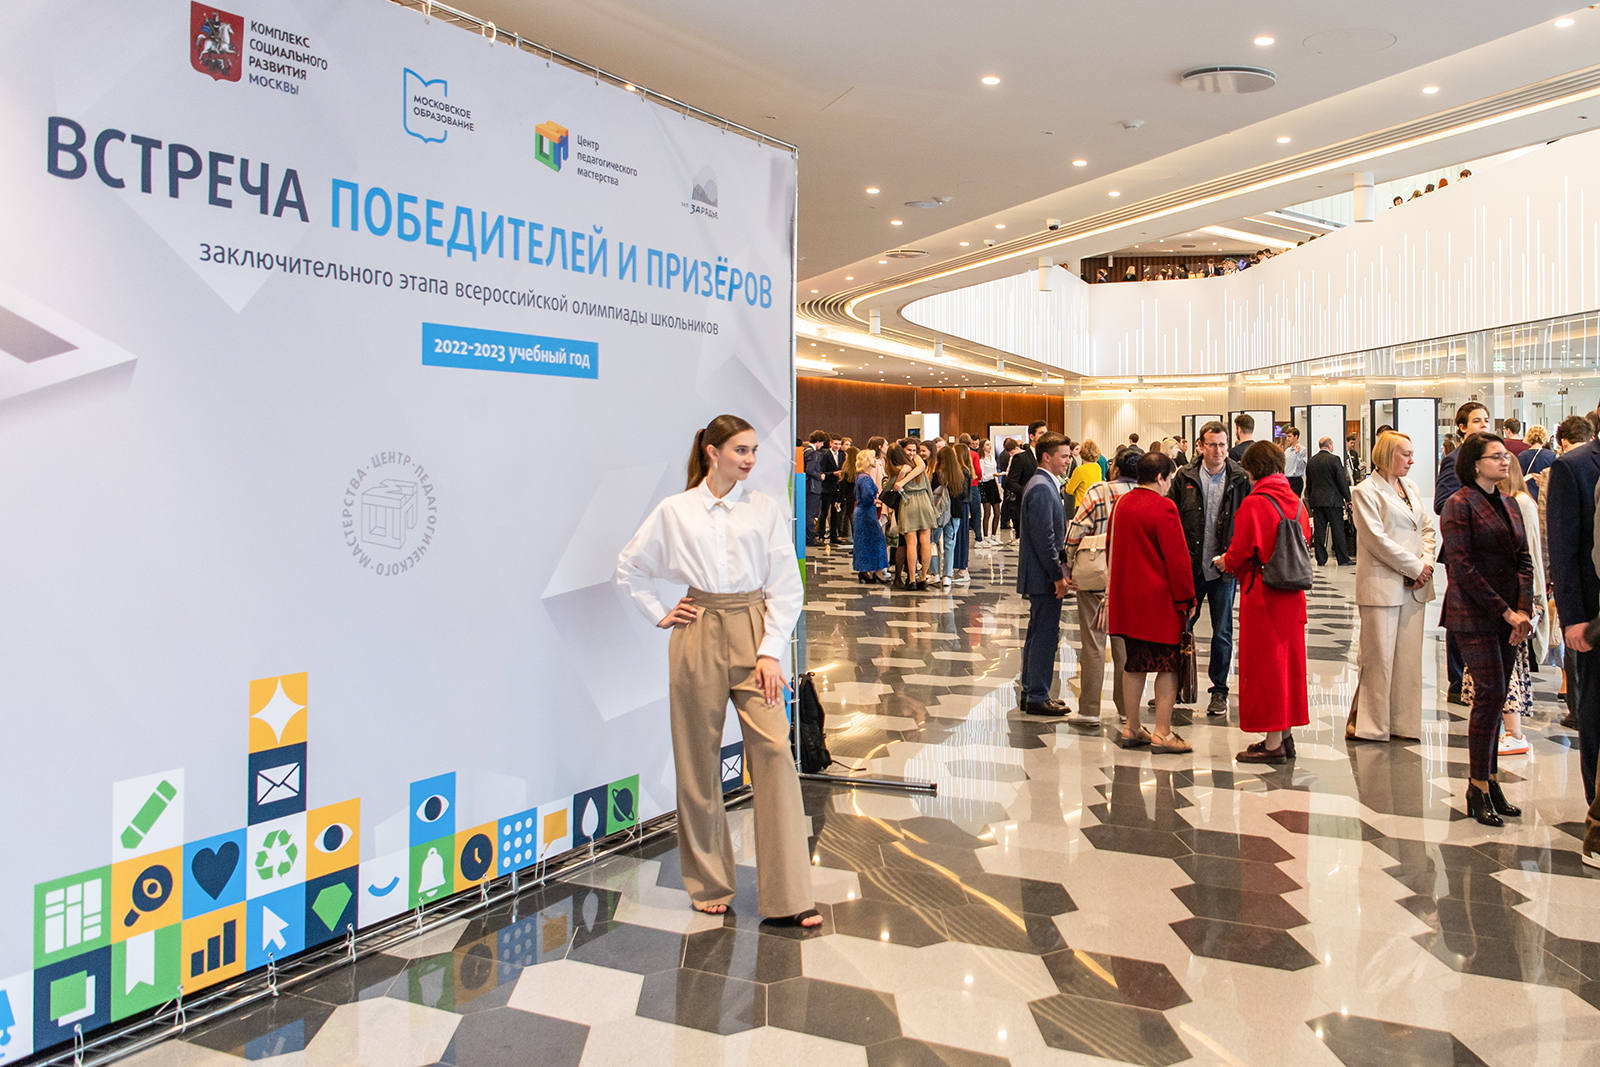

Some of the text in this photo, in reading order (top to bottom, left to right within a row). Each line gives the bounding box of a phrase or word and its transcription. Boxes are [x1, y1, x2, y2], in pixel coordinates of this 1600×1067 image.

[250, 20, 310, 48] КОМПЛЕКС
[249, 38, 328, 70] СОЦИАЛЬНОГО
[248, 55, 307, 81] РАЗВИТИЯ
[248, 73, 299, 95] МОСКВЫ
[413, 94, 472, 119] МОСКОВСКОЕ
[413, 106, 475, 132] ОБРАЗОВАНИЕ
[576, 134, 600, 152] Центр
[576, 151, 638, 177] педагогического
[576, 167, 619, 187] мастерства
[46, 115, 773, 309] ВСТРЕЧА ПОБЕДИТЕЛЕЙ И ПРИЗЁРОВ
[199, 242, 719, 336] заключительного этапа всероссийской олимпиады школьников
[434, 337, 591, 371] 2022-2023 учебный год
[371, 451, 412, 468] ЦЕНТР
